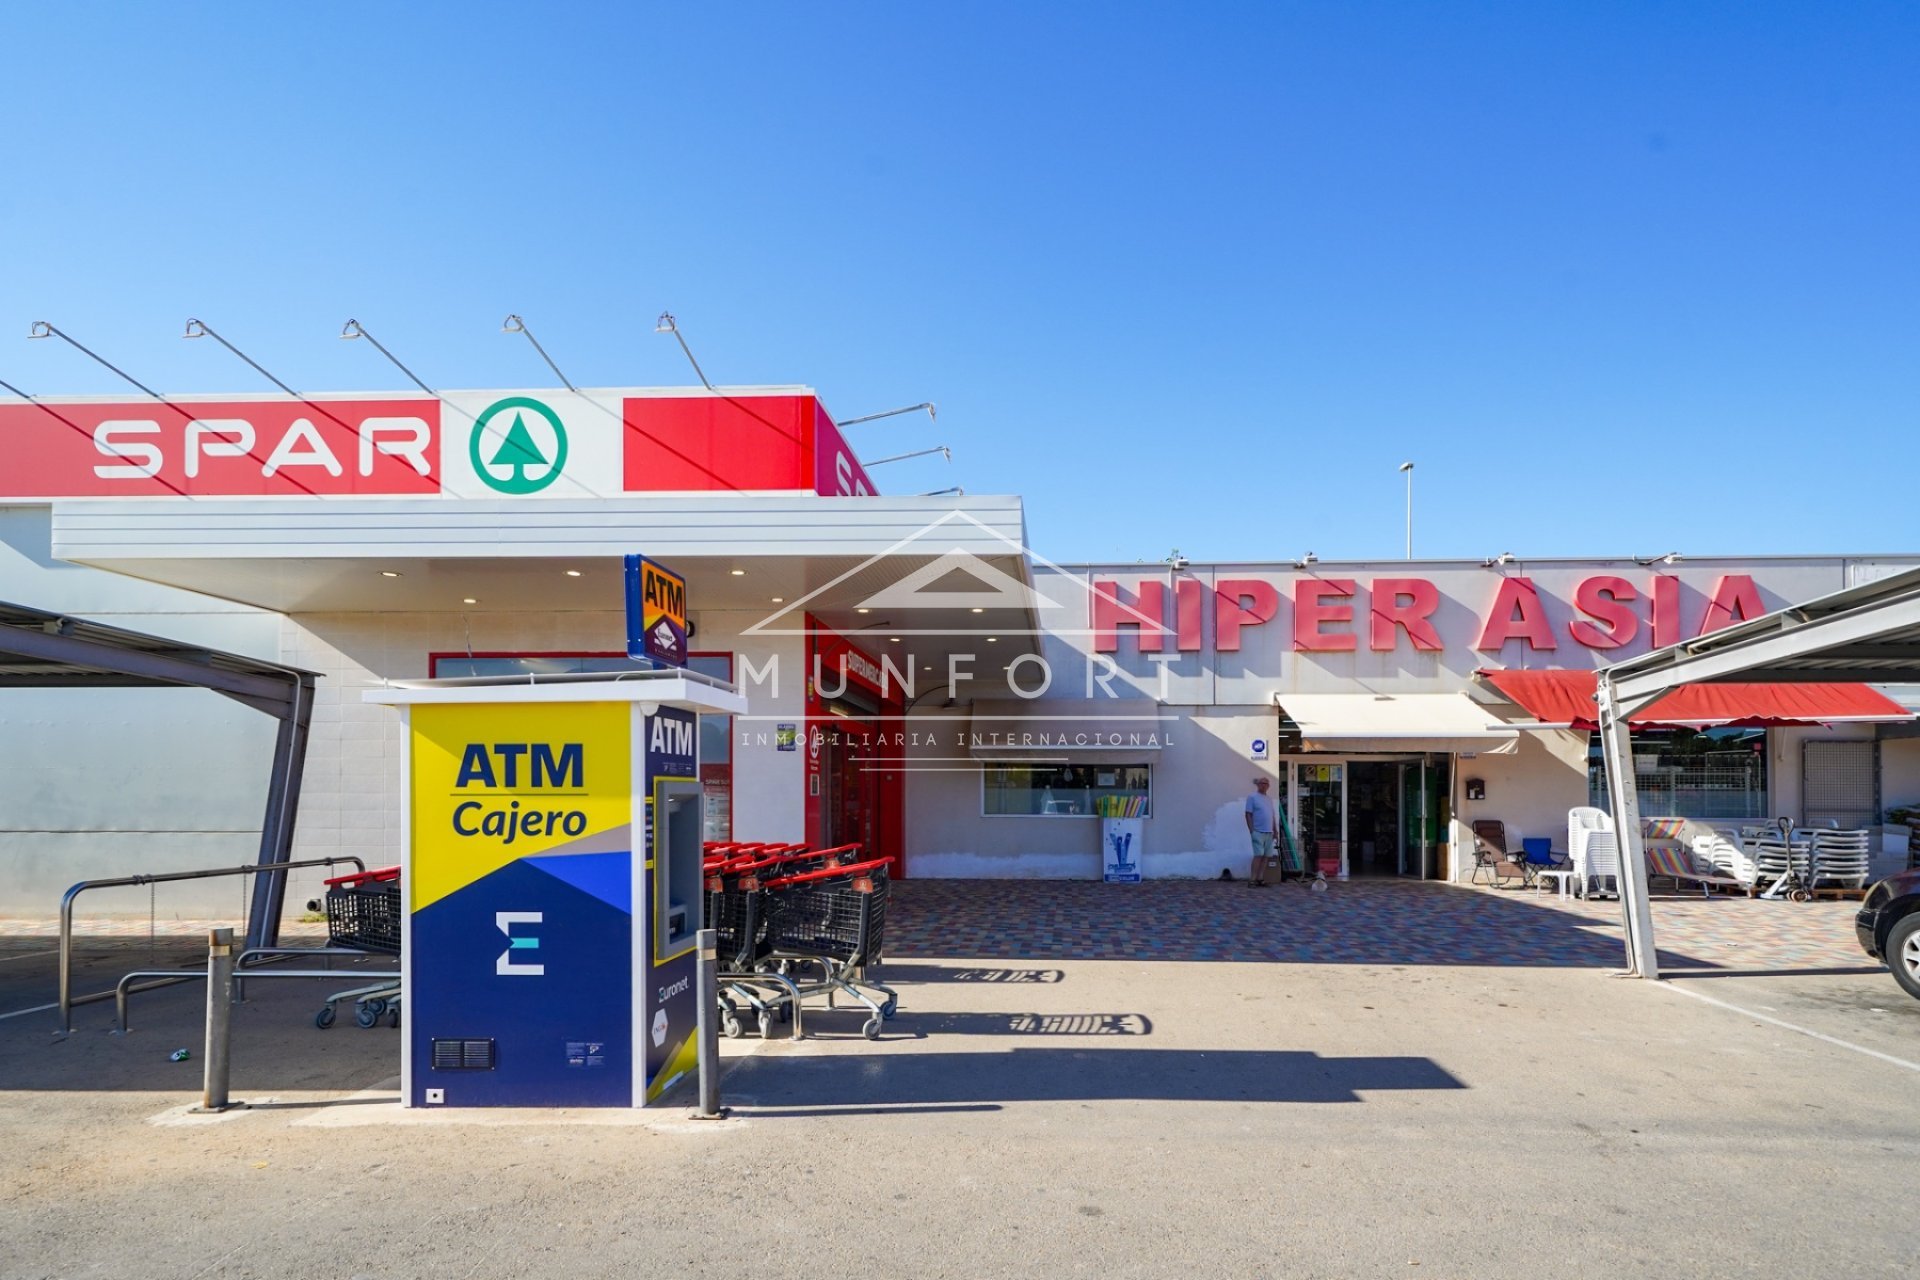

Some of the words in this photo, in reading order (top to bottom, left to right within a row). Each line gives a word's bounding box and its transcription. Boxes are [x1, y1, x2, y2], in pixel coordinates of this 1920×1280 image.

[93, 417, 431, 478] SPAR
[645, 569, 683, 619] ATM
[1093, 578, 1443, 652] HIPER
[1477, 575, 1767, 650] ASIA
[650, 715, 692, 756] ATM
[455, 743, 584, 788] ATM
[452, 800, 587, 845] Cajero
[658, 975, 689, 1003] Euronet
